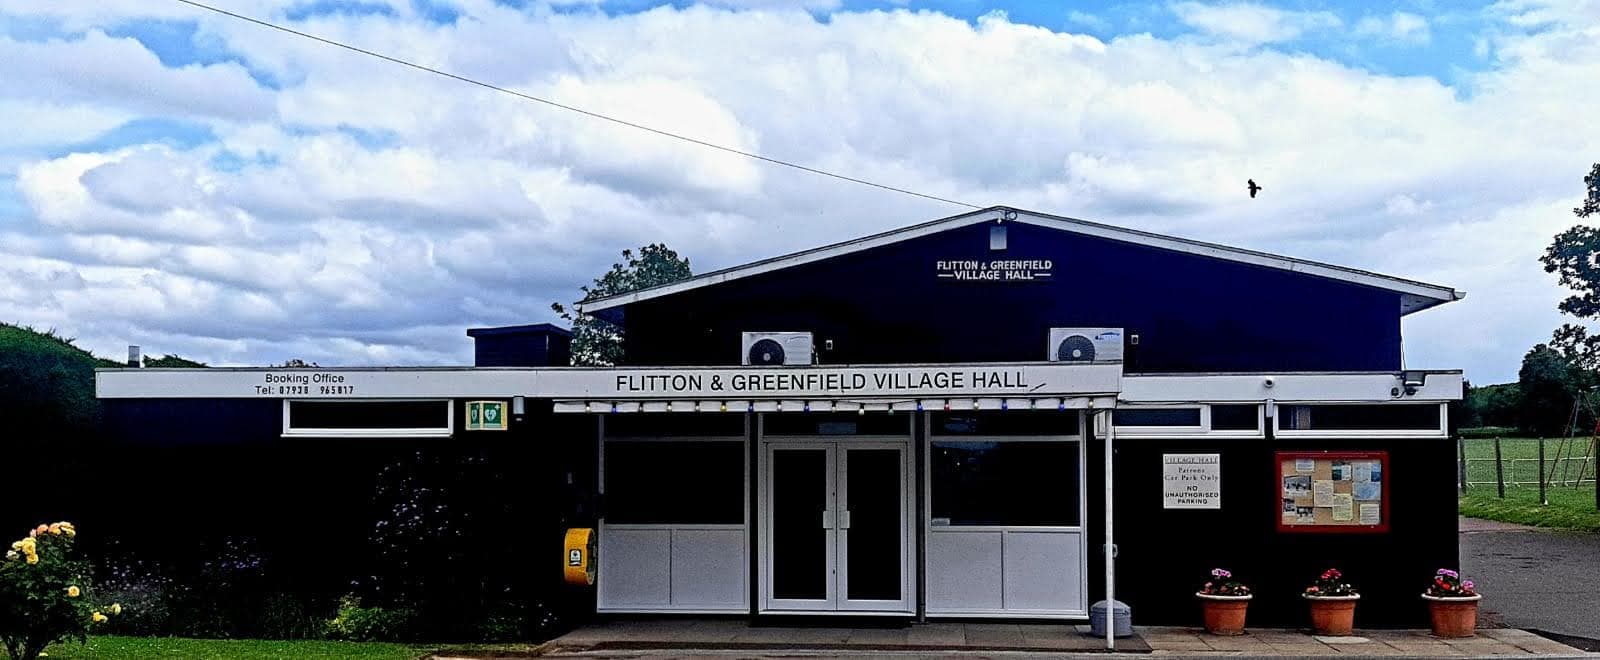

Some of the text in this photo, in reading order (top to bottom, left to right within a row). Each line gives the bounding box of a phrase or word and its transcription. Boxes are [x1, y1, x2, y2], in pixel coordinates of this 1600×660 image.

[937, 260, 1052, 270] FLITTON & GREENFIELD
[954, 270, 1034, 280] VILLAGE HALL
[265, 373, 345, 384] Booking Office
[616, 371, 1028, 391] FLITTON & GREENFIELD VILLAGE HALL
[255, 386, 275, 395] Tel:
[1200, 474, 1218, 482] Only
